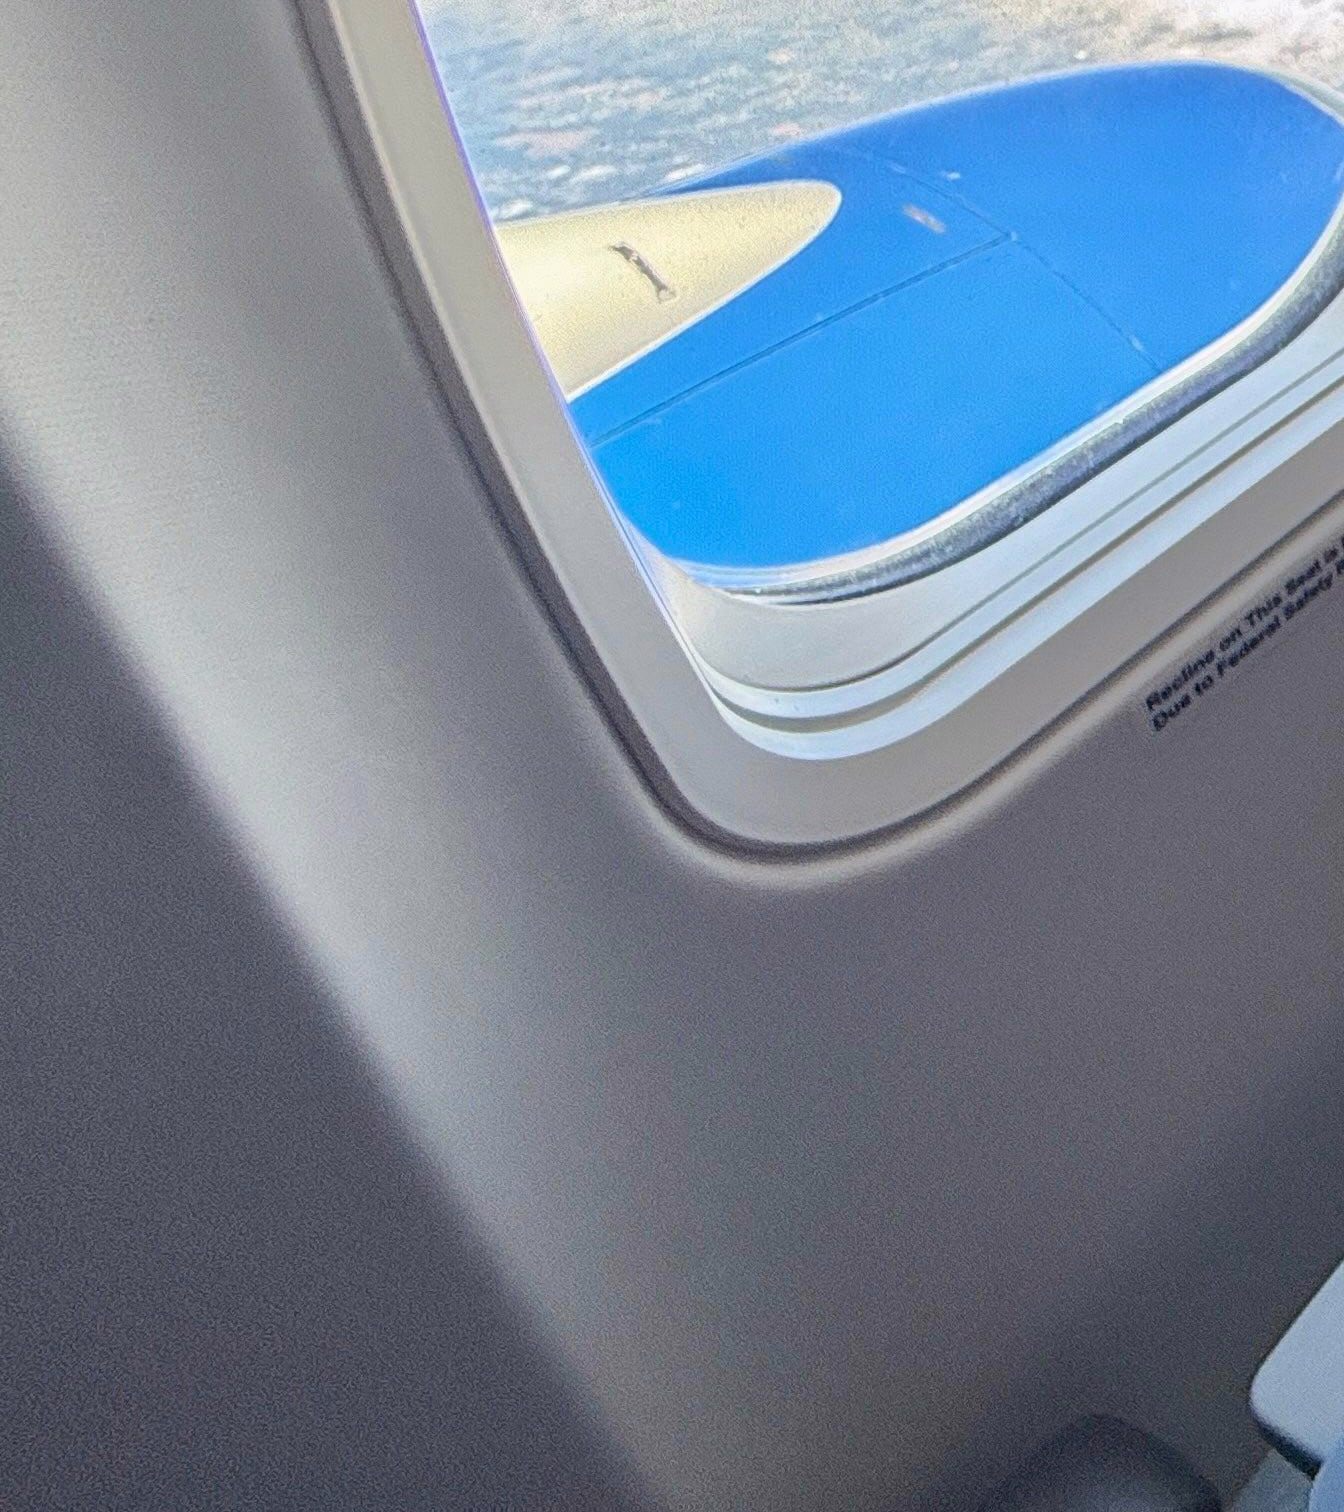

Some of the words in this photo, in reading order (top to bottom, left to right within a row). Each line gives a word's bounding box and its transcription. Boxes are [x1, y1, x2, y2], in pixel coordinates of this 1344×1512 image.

[1146, 649, 1215, 710] Recline
[1220, 627, 1242, 651] on
[1245, 594, 1282, 627] This
[1285, 560, 1321, 595] Seat
[1324, 548, 1338, 563] is
[1153, 694, 1191, 731] Due
[1194, 675, 1213, 695] to
[1216, 616, 1281, 676] Federal
[1284, 574, 1332, 621] Safety
